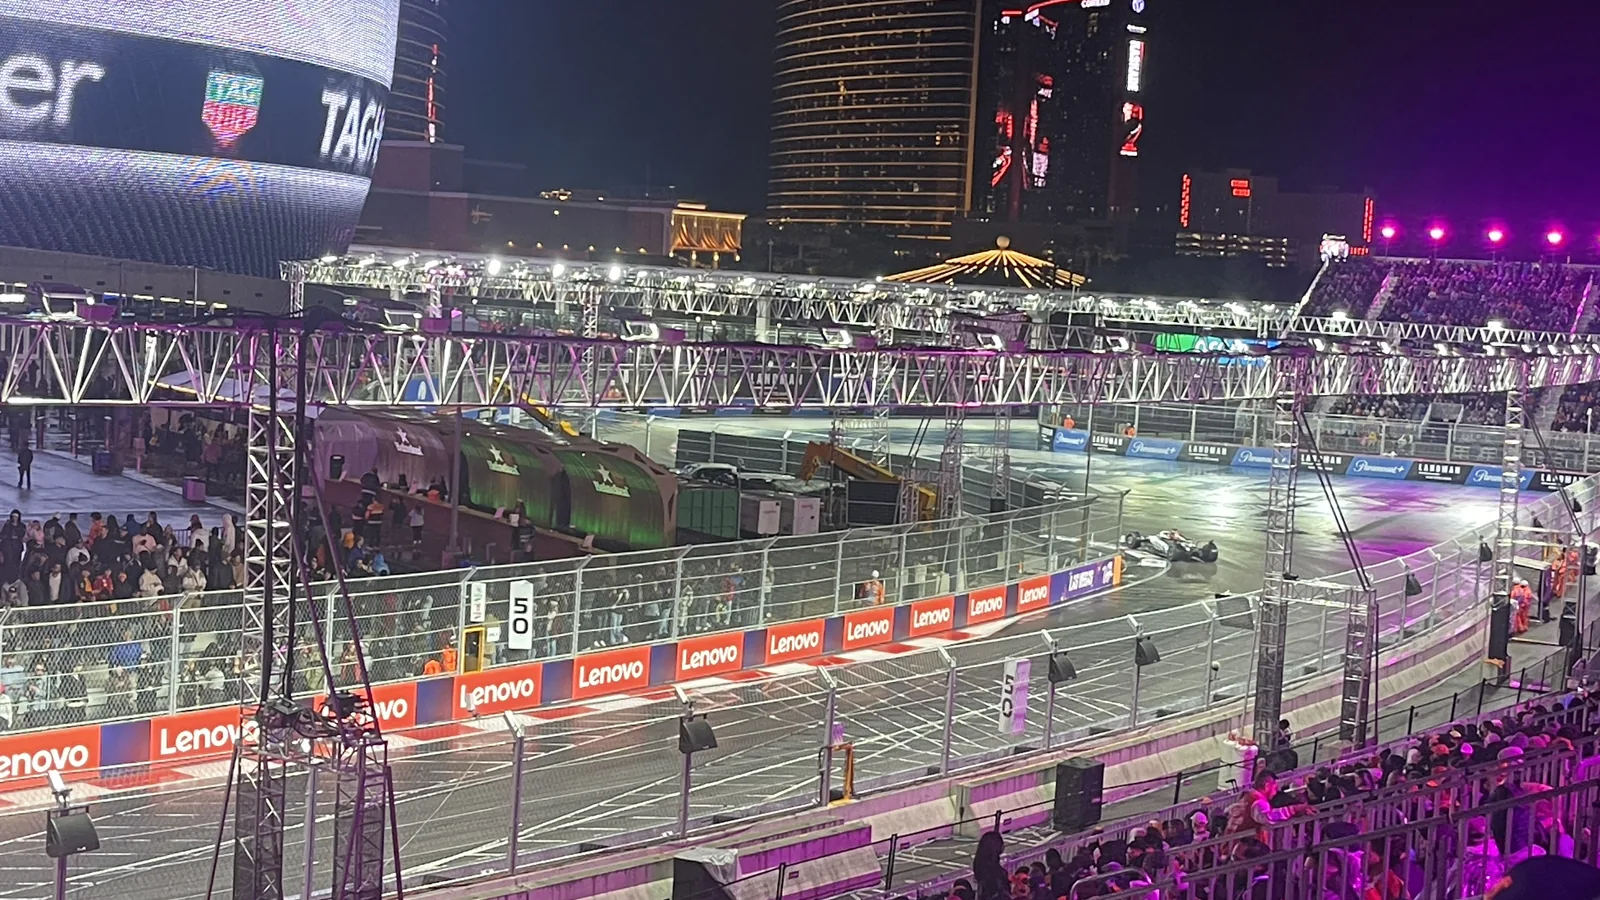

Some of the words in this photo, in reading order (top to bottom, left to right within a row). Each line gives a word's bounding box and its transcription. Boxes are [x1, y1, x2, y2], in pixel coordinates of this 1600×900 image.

[970, 596, 1003, 617] Lenovo
[1019, 586, 1048, 605] Lenovo
[847, 618, 890, 641] Lenovo
[913, 607, 950, 629] Lenovo
[770, 631, 819, 655] Lenovo
[681, 645, 737, 670] Lenovo
[578, 660, 644, 688] Lenovo
[459, 678, 534, 708] Lenovo
